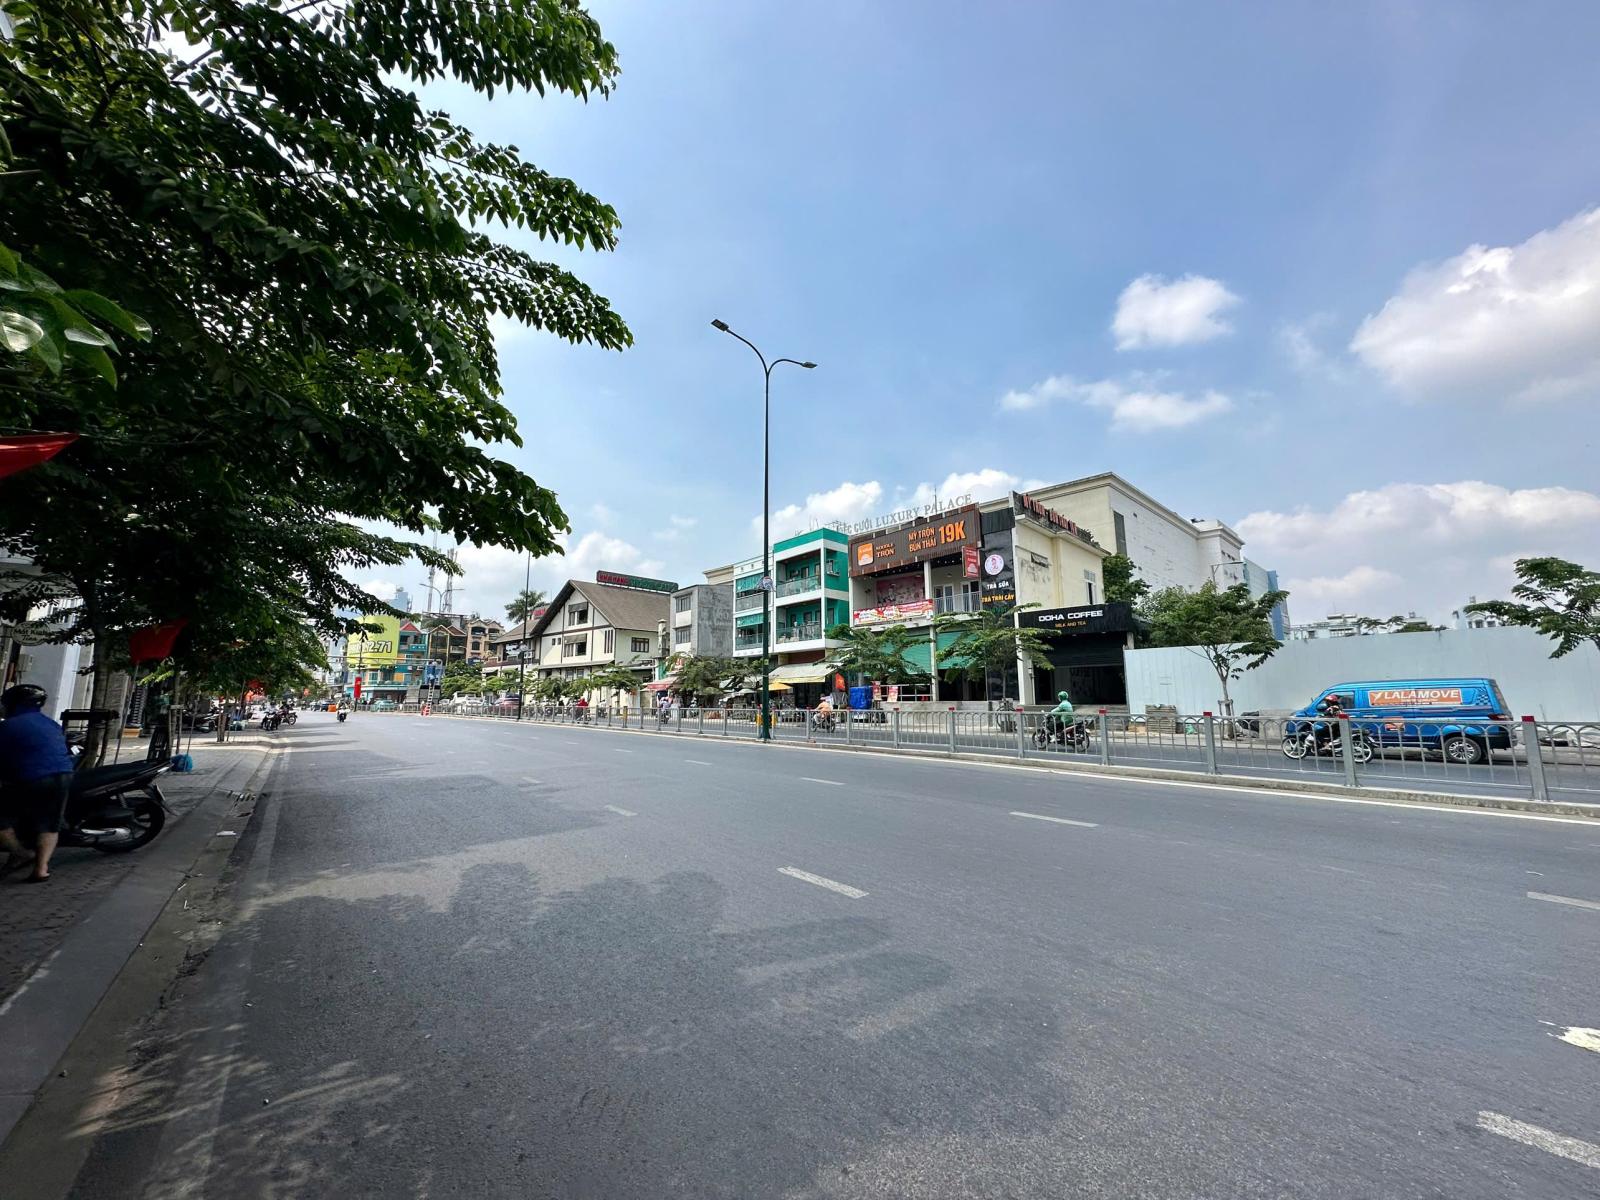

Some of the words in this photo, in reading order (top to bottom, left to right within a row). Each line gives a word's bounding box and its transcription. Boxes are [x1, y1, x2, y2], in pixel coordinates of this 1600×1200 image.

[875, 506, 920, 526] LUXURY
[924, 493, 972, 515] PALACE
[938, 520, 966, 544] 19K
[1038, 613, 1065, 622] DOHA
[1067, 609, 1103, 620] COFFEE
[1384, 690, 1459, 699] LALAMOVE
